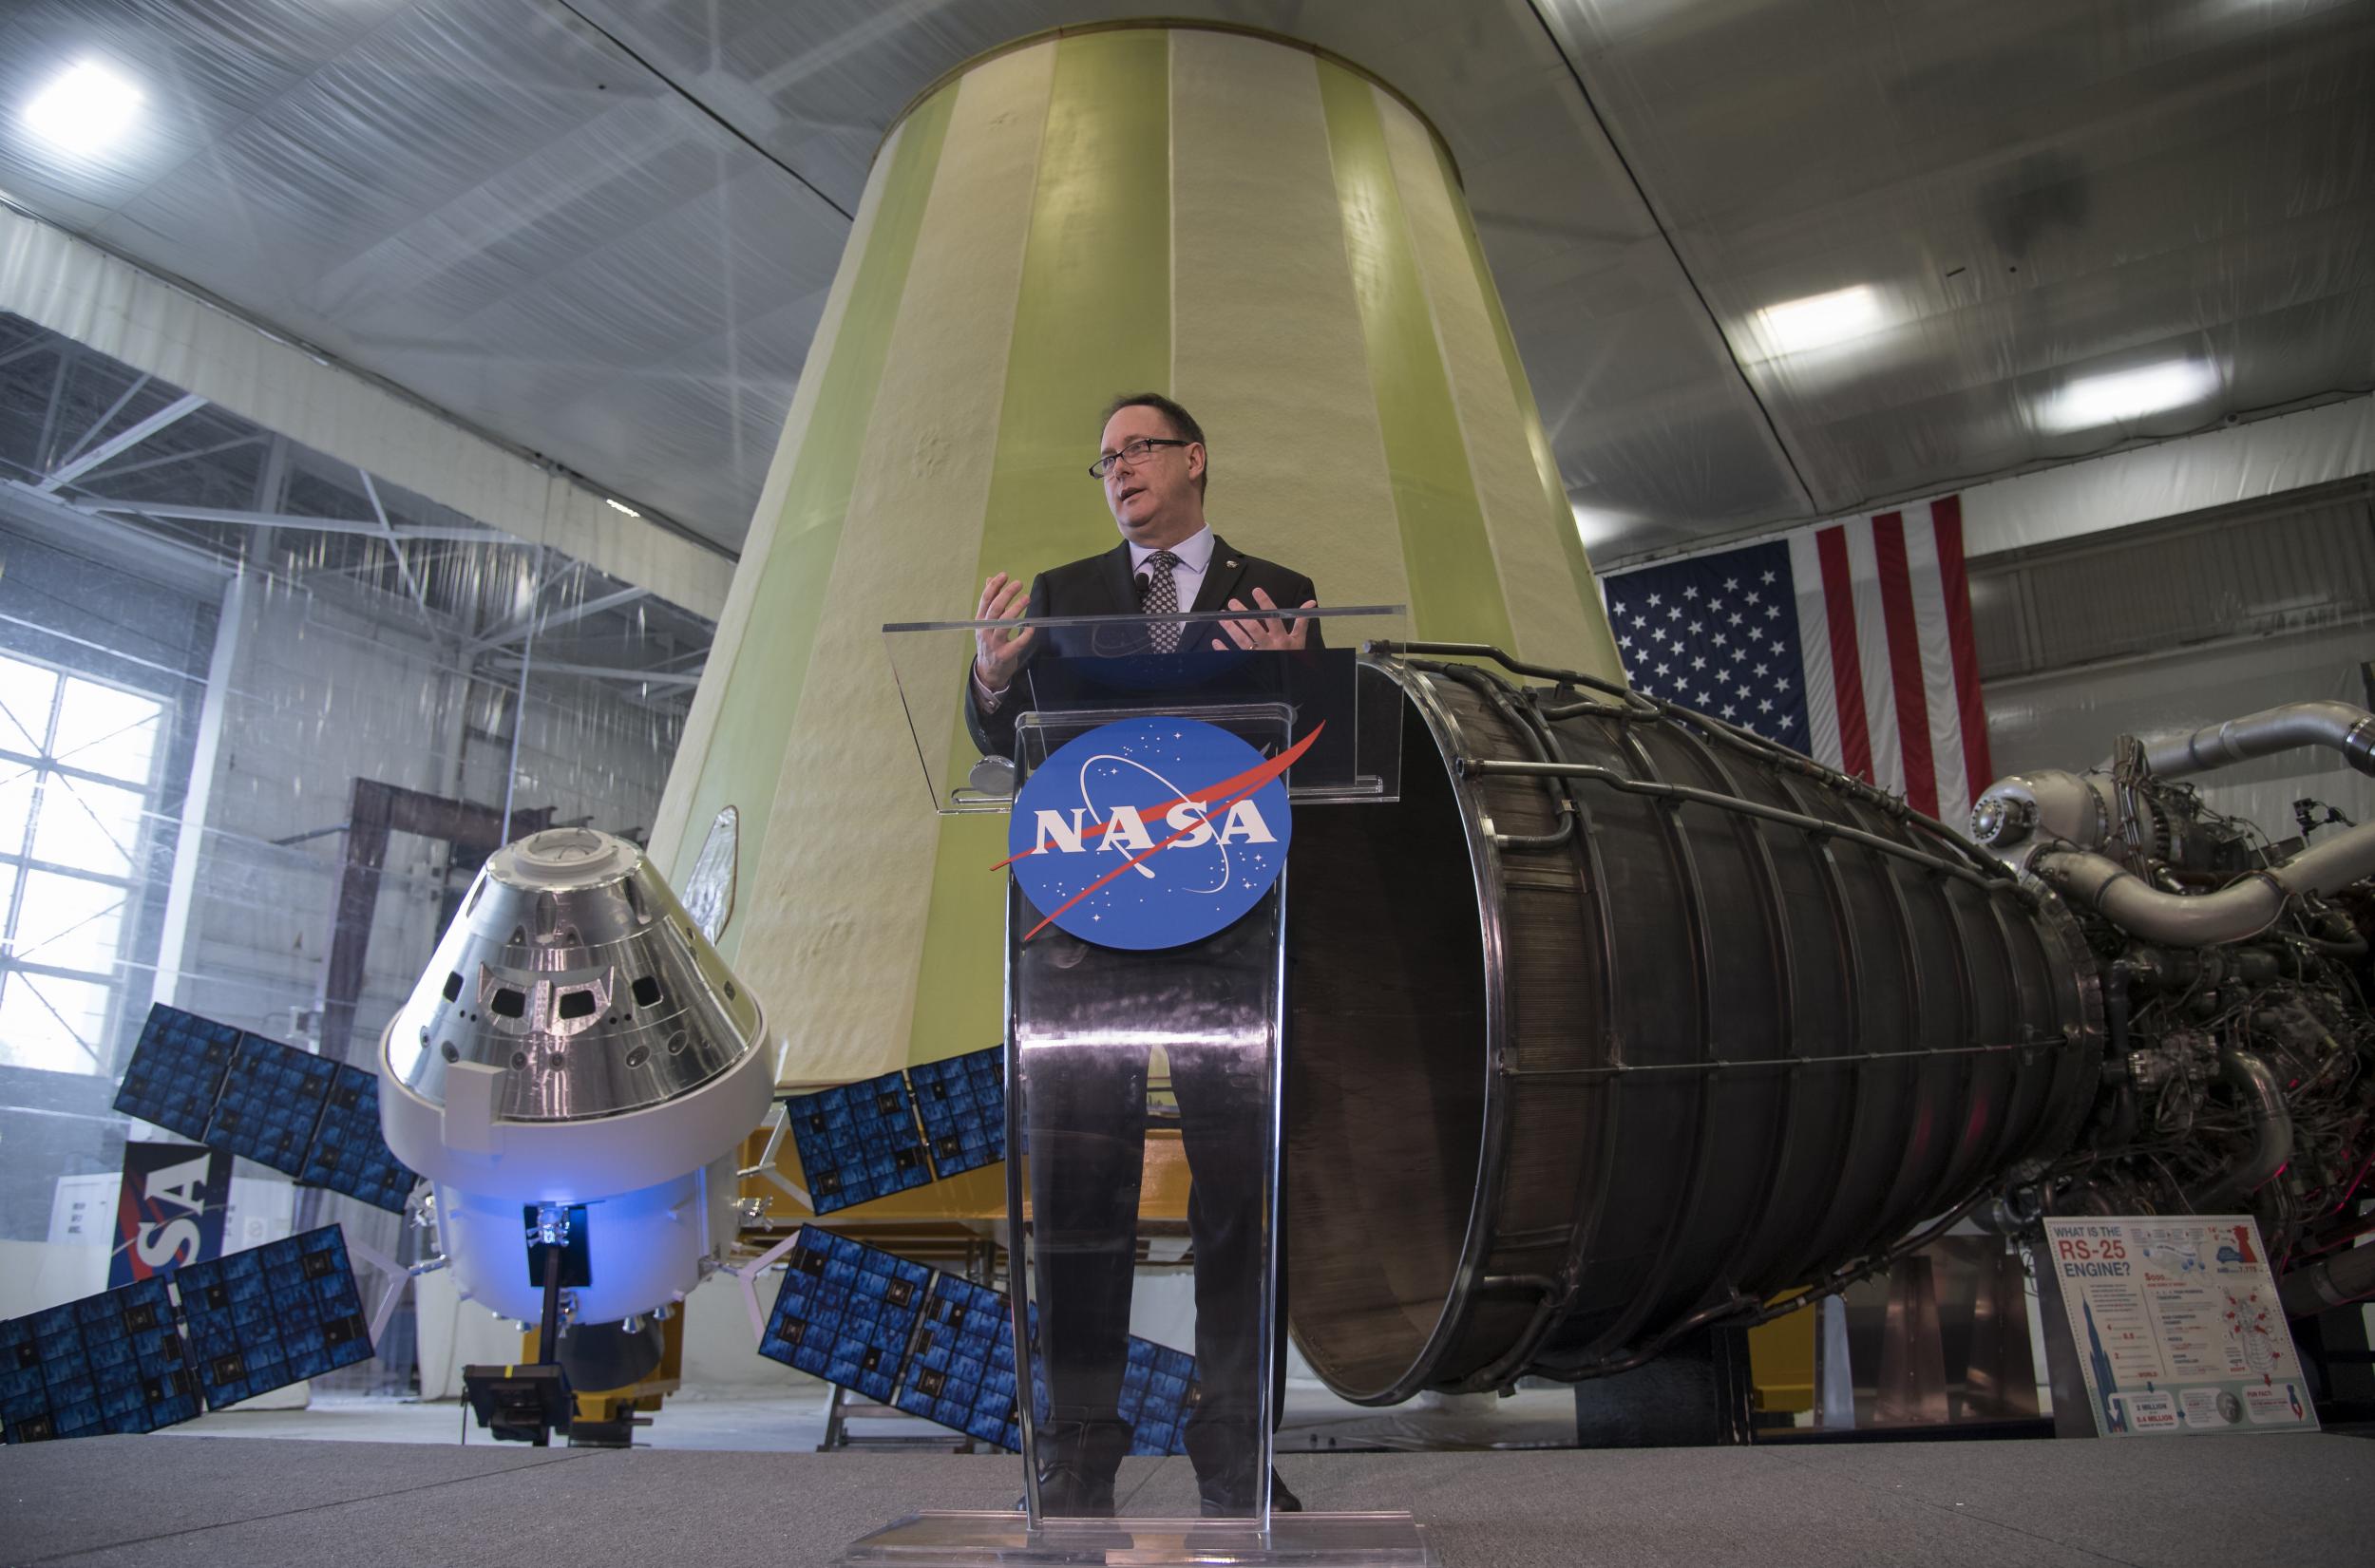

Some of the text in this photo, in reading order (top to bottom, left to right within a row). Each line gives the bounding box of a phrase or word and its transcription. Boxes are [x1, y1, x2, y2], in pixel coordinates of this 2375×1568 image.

[1032, 799, 1278, 854] NASA
[136, 1152, 212, 1271] SA
[2053, 1226, 2084, 1237] WHAT
[2087, 1226, 2099, 1237] IS
[2100, 1226, 2122, 1237] THE
[2058, 1239, 2126, 1260] RS-25
[2064, 1261, 2131, 1277] ENGINE?
[2142, 1403, 2167, 1411] MILLION
[2148, 1414, 2174, 1423] MILLION
